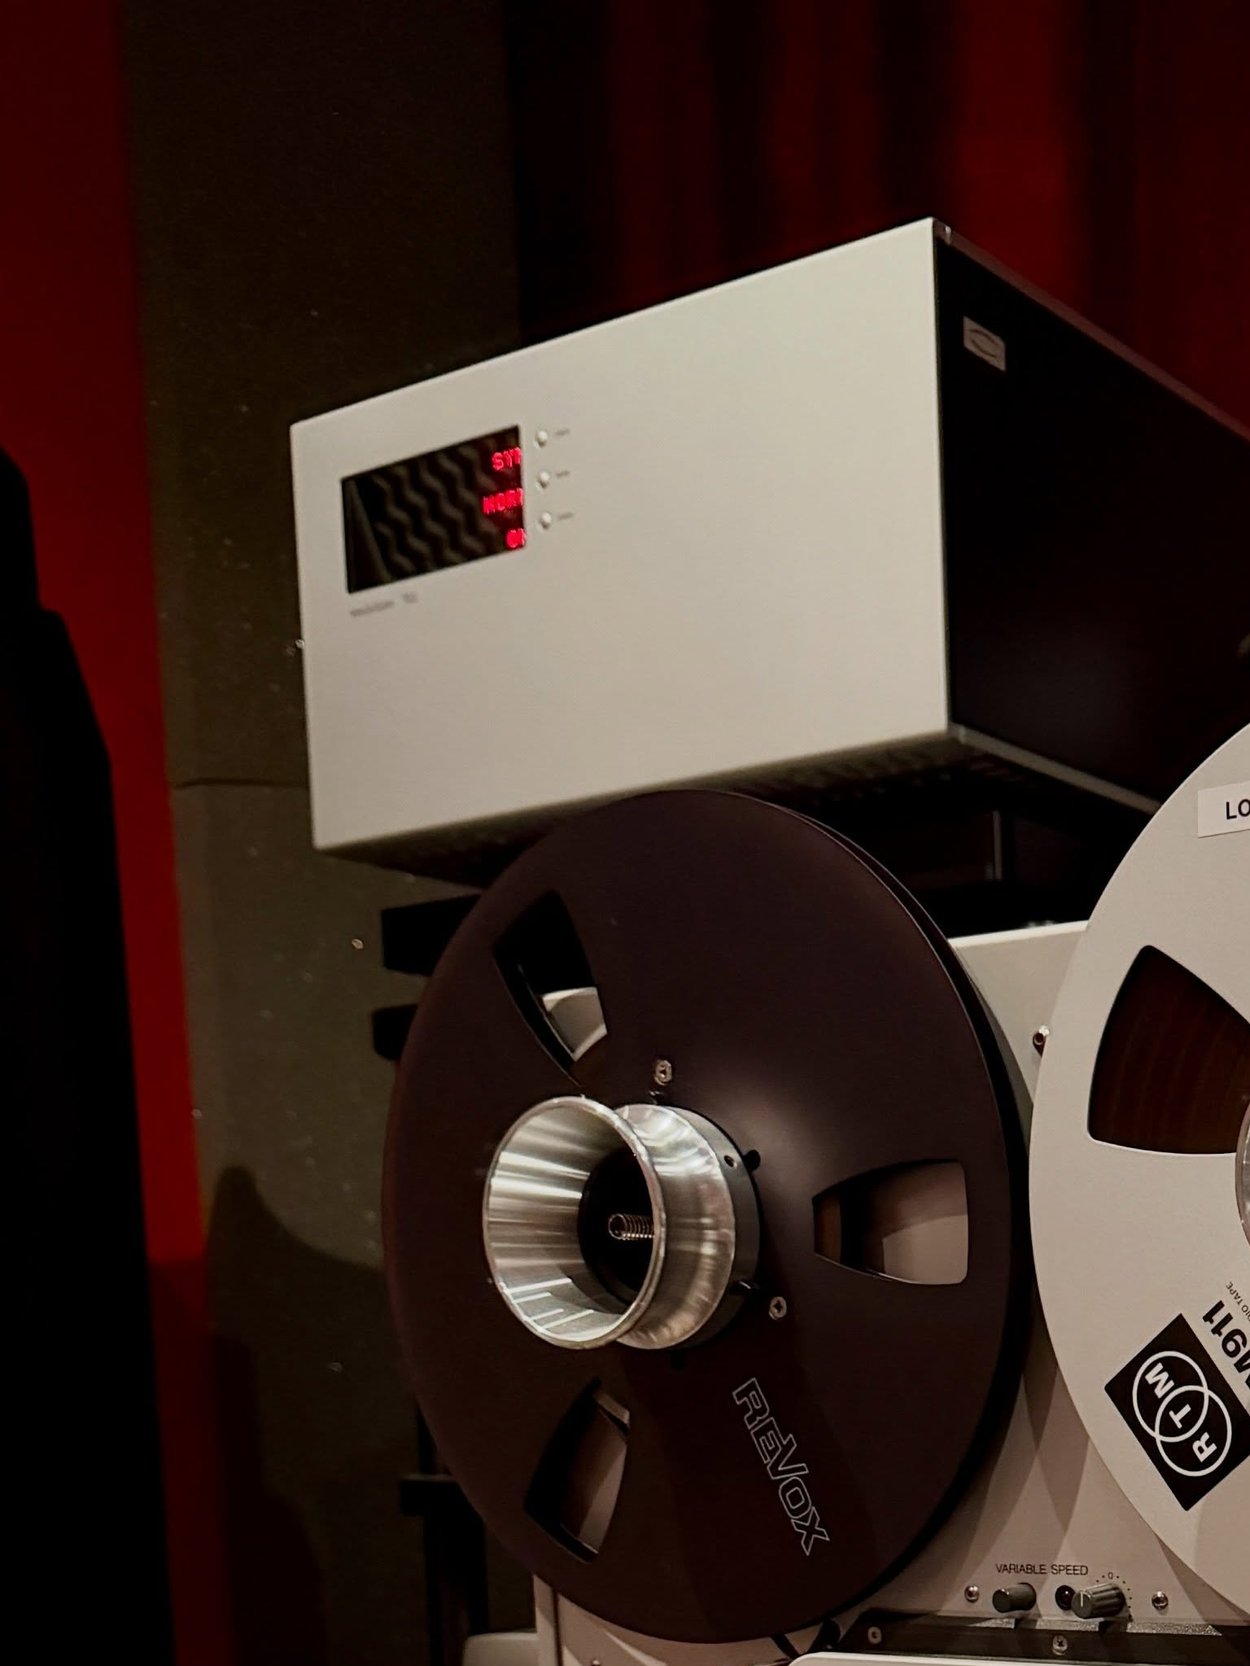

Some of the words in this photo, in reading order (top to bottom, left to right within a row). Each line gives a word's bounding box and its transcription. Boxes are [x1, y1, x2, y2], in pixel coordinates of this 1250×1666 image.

[1225, 1281, 1243, 1305] TAPE
[996, 1563, 1047, 1575] VARIABLE
[1051, 1564, 1089, 1576] SPEED
